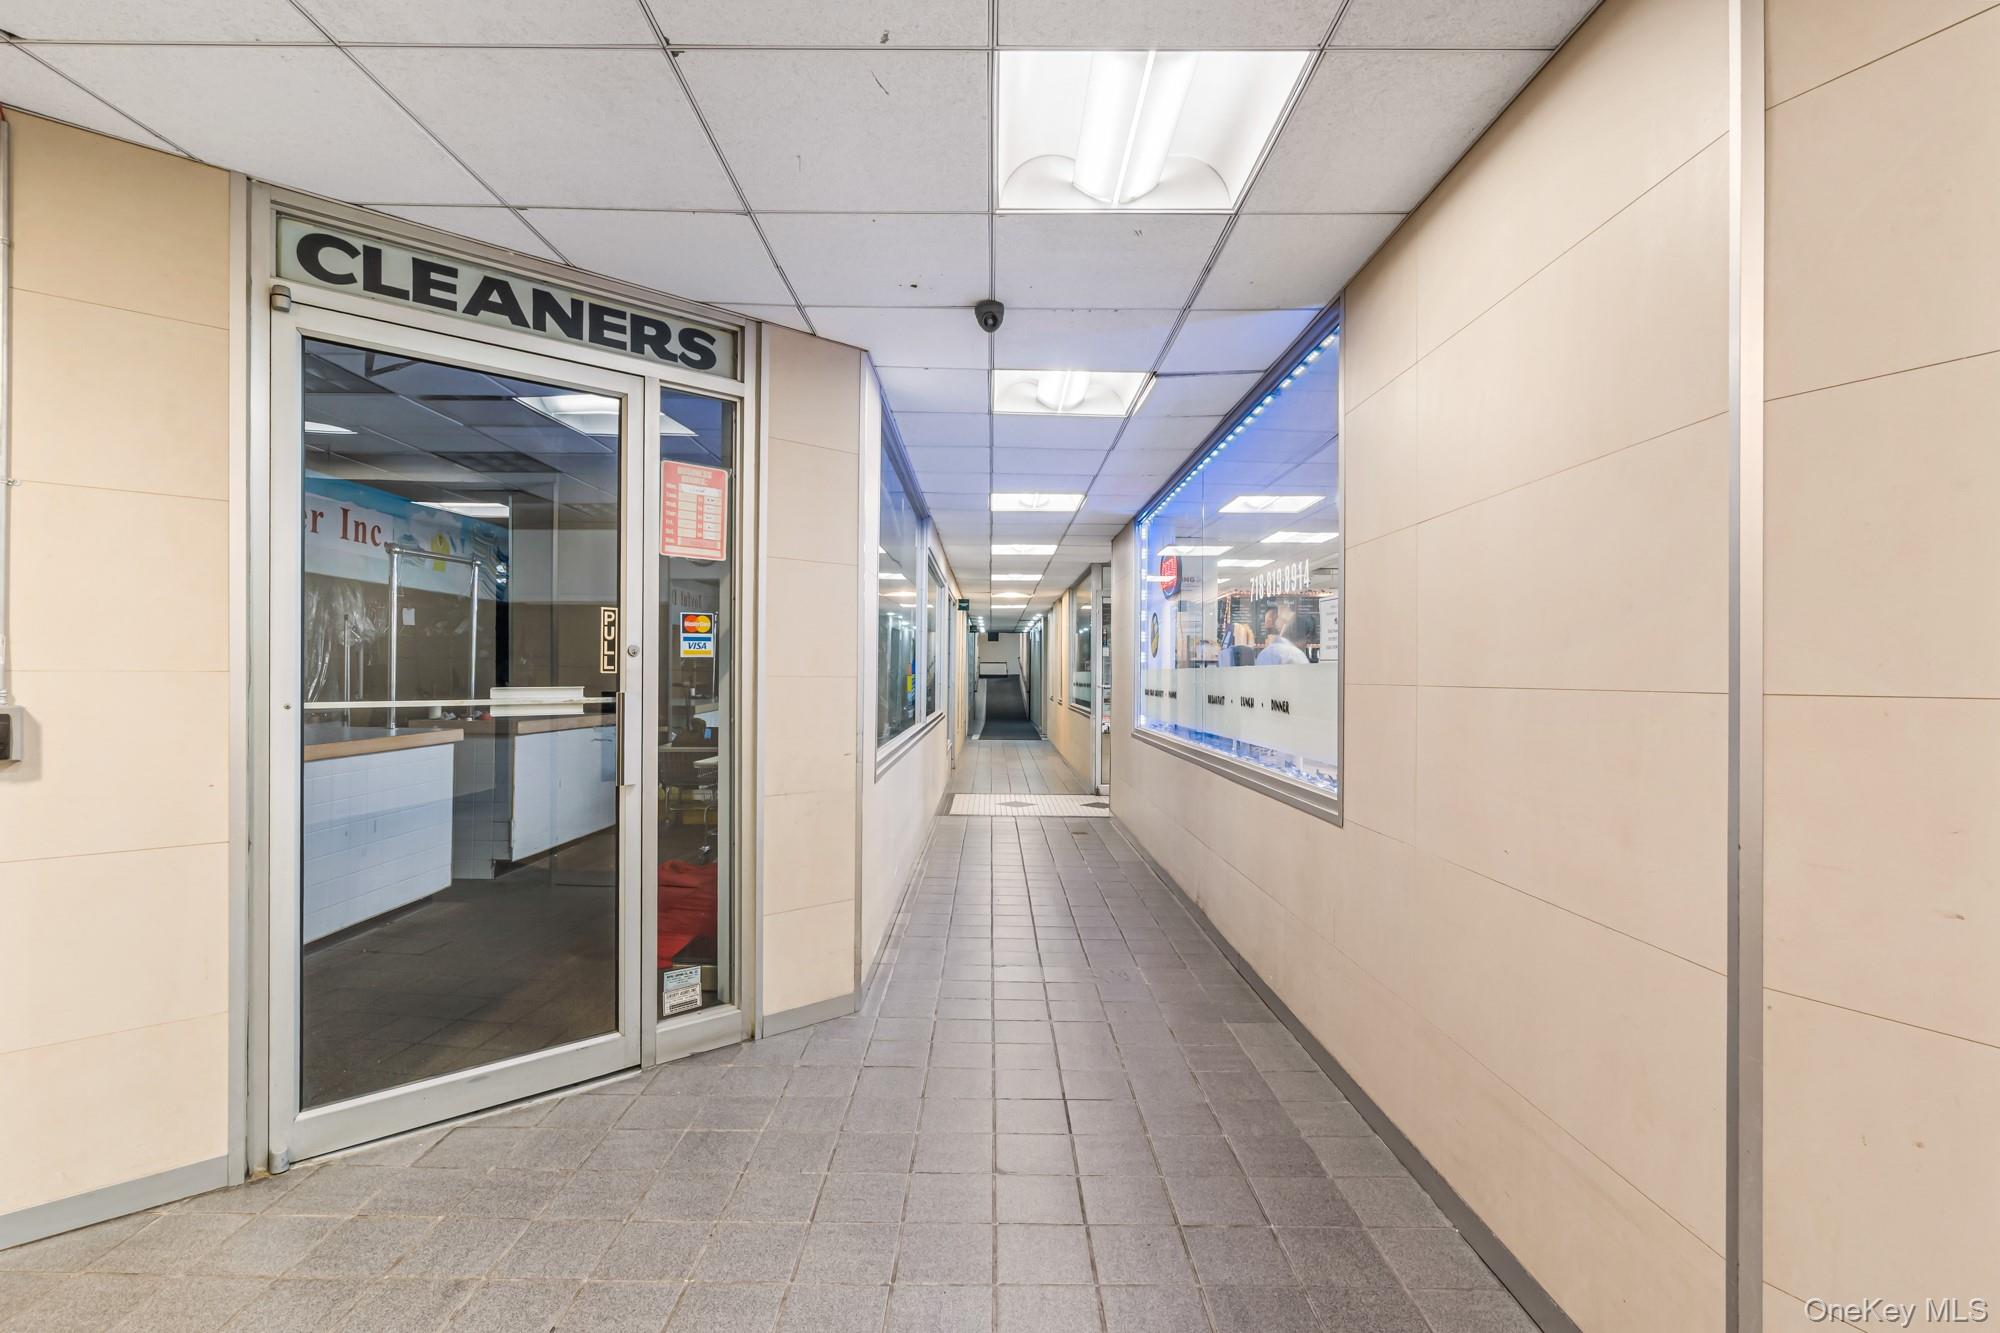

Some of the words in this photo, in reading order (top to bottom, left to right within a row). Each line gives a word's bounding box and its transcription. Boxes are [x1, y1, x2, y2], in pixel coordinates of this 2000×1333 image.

[296, 232, 718, 370] CLEANERS
[603, 611, 615, 670] PULL
[687, 641, 707, 650] VISA
[1270, 699, 1290, 715] DINNER
